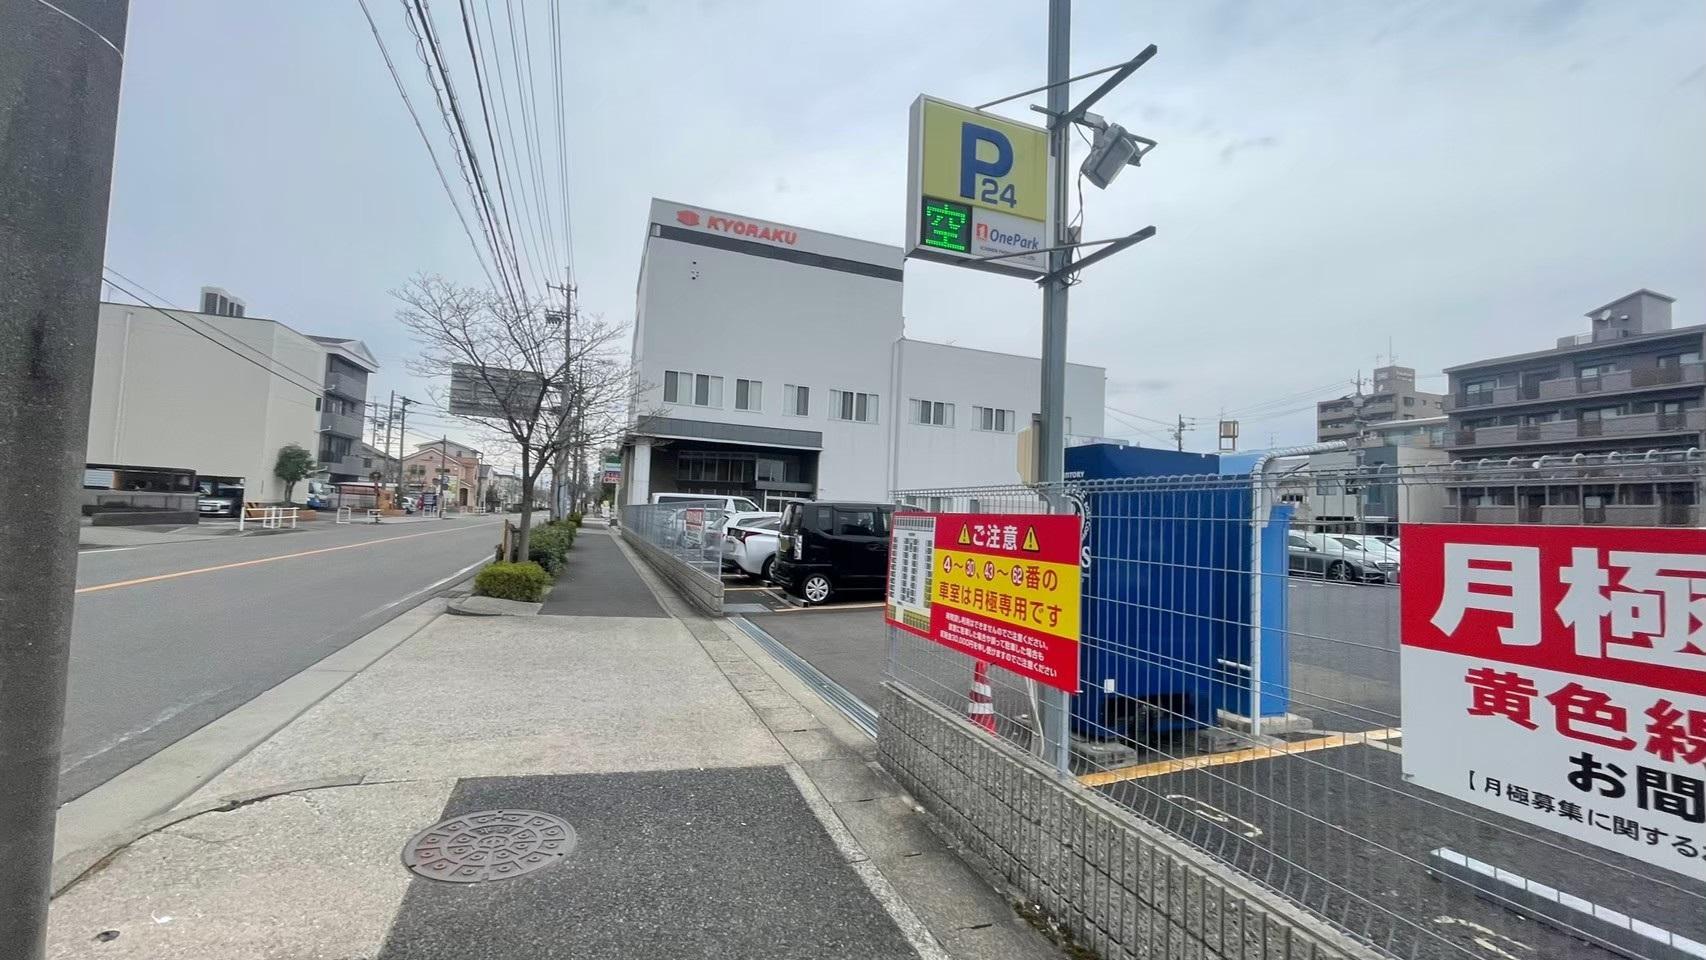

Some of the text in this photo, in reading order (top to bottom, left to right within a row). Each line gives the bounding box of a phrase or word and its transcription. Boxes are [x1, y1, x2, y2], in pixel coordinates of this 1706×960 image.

[960, 121, 1014, 200] P
[981, 178, 1017, 208] 24
[706, 215, 798, 246] KYORAKU
[926, 203, 966, 250] 空
[990, 229, 1039, 250] OnePark
[973, 524, 1018, 551] ご注意
[939, 581, 1062, 628] 車室は月極専用です
[1430, 543, 1706, 671] 月極
[1469, 770, 1706, 861] 【月極募集に関する
